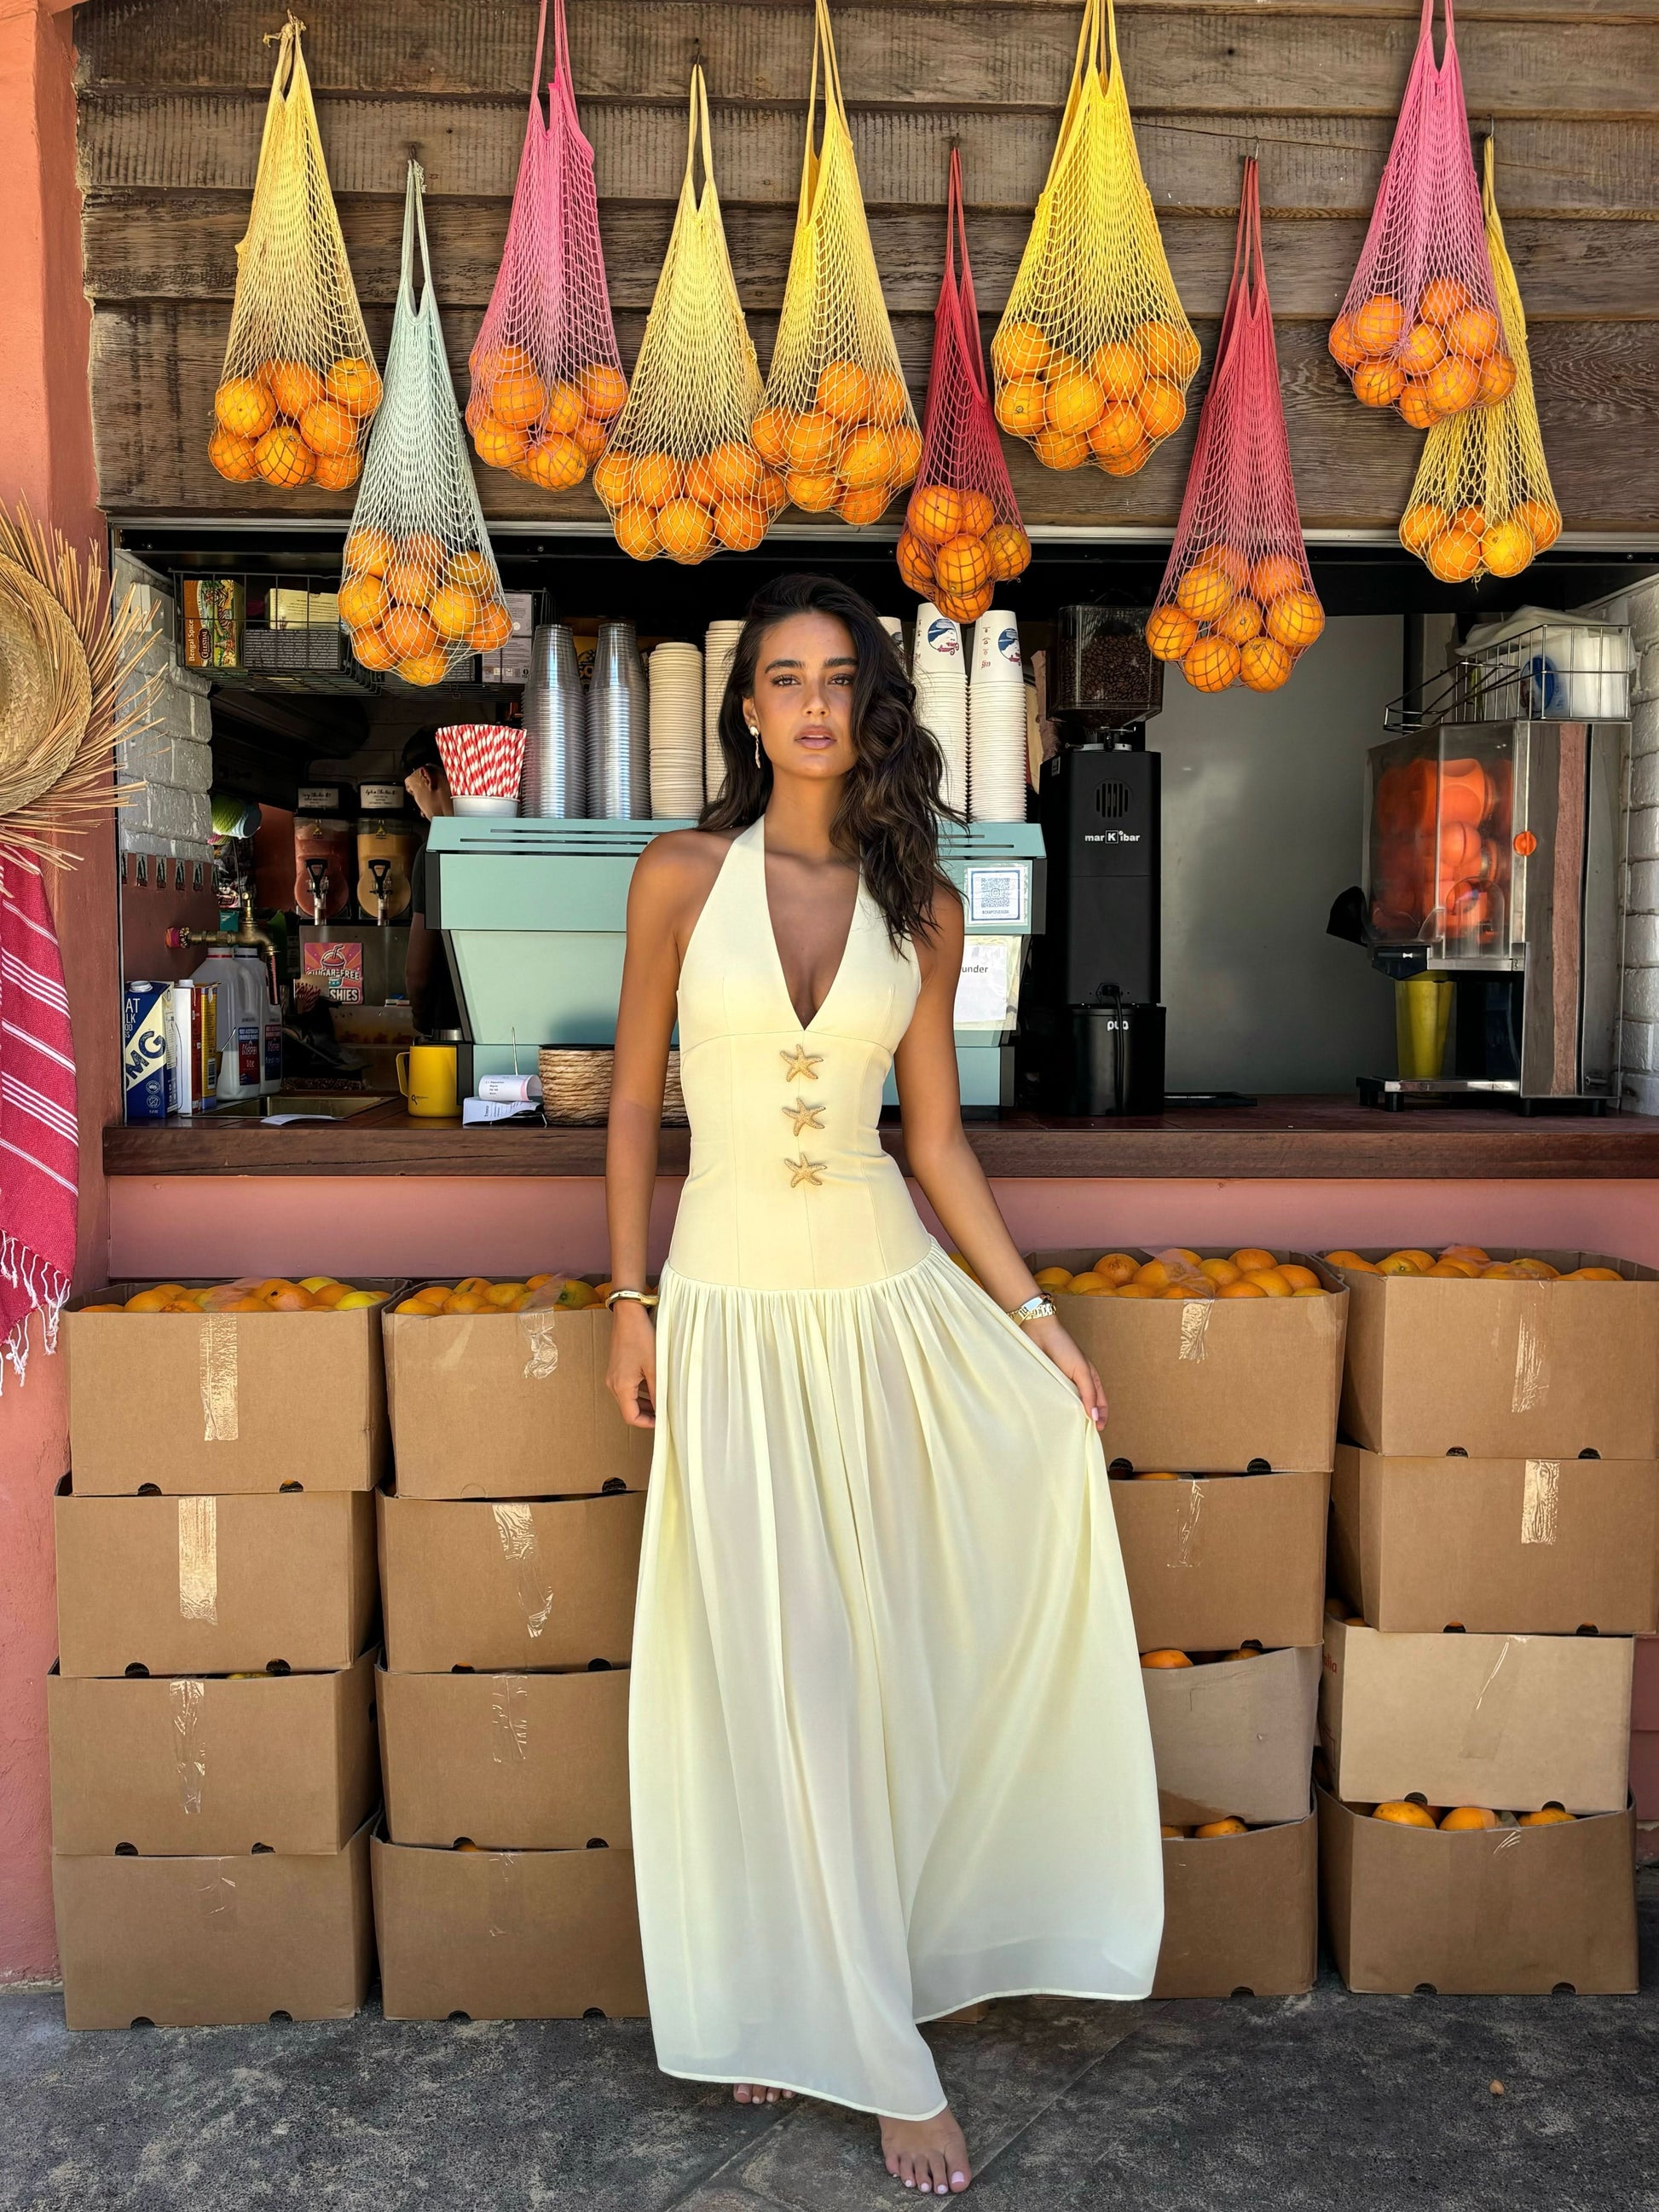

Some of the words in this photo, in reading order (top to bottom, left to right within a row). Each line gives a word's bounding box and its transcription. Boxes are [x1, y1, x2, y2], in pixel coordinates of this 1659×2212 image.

[188, 619, 196, 638] Spice
[188, 638, 197, 661] Bengal
[329, 989, 359, 1002] SHIES
[125, 998, 141, 1014] AT
